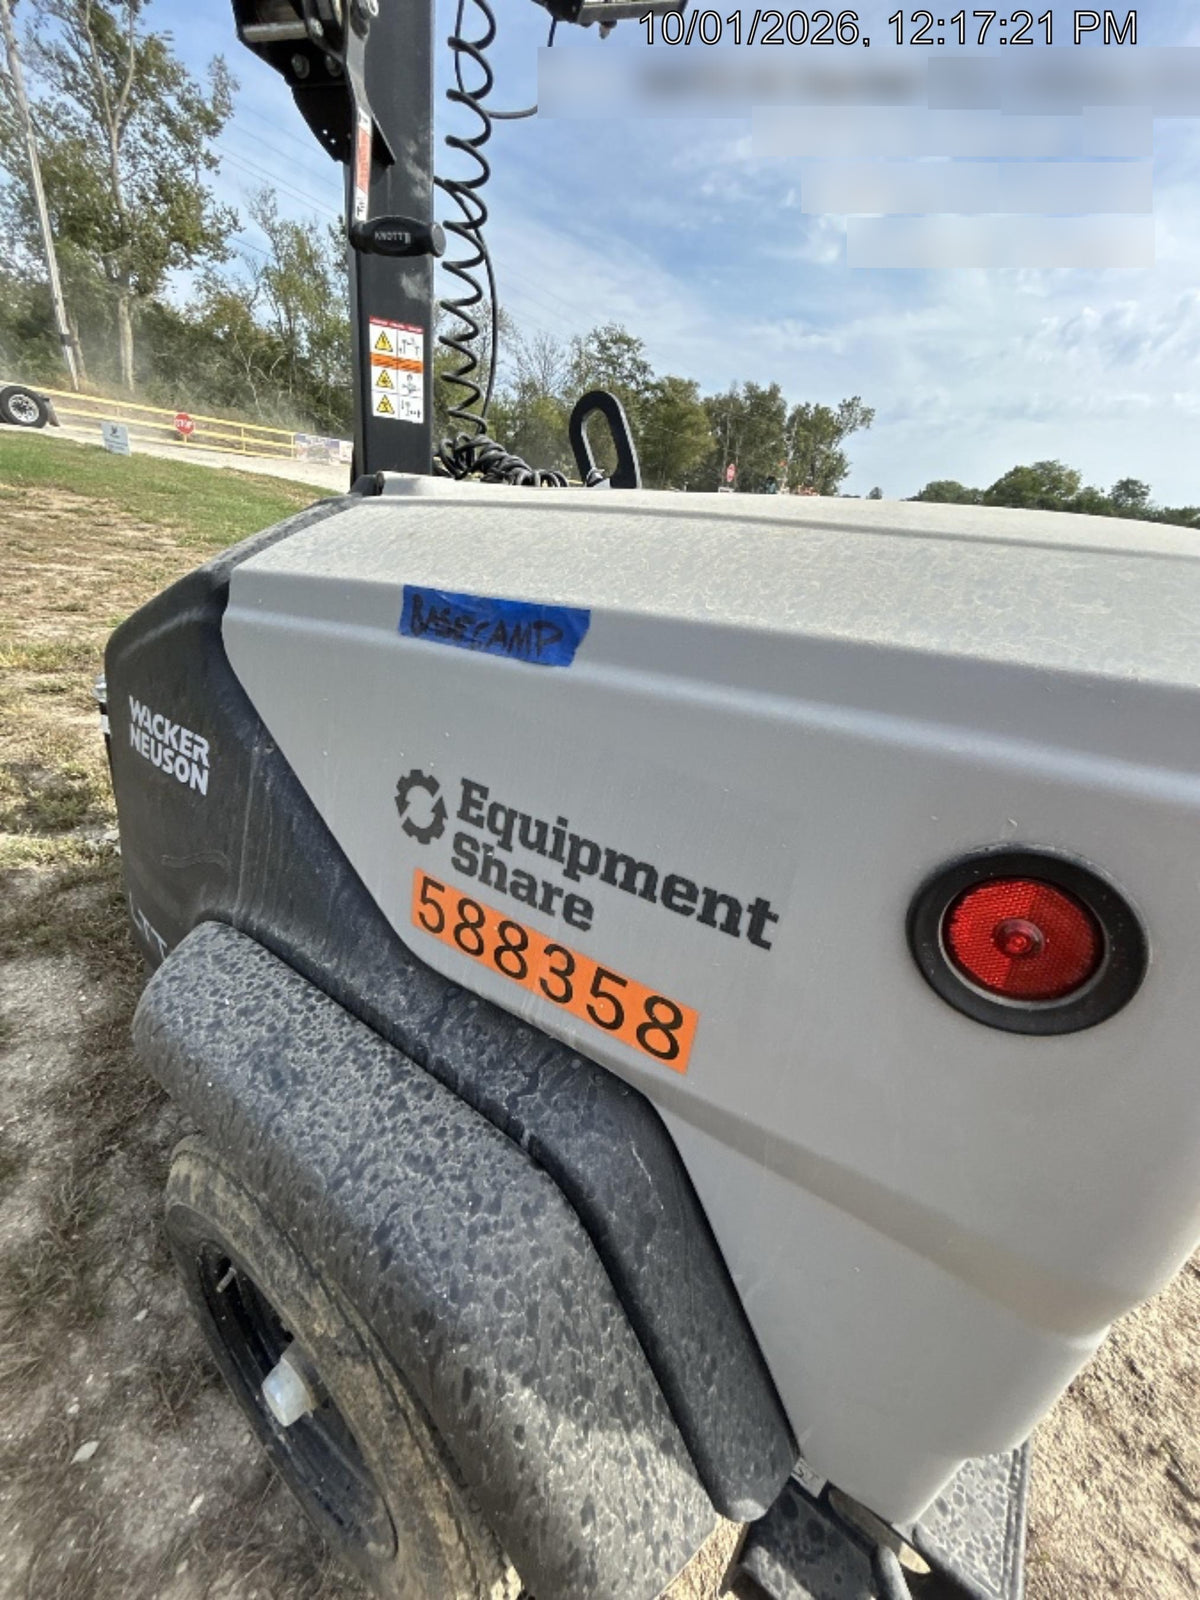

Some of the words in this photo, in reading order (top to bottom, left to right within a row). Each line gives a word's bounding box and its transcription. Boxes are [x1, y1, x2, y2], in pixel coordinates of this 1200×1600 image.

[129, 695, 211, 768] WACKER
[130, 722, 209, 796] NEUSON
[451, 831, 594, 932] Share
[456, 777, 779, 950] Equipment
[418, 876, 684, 1061] 588358
